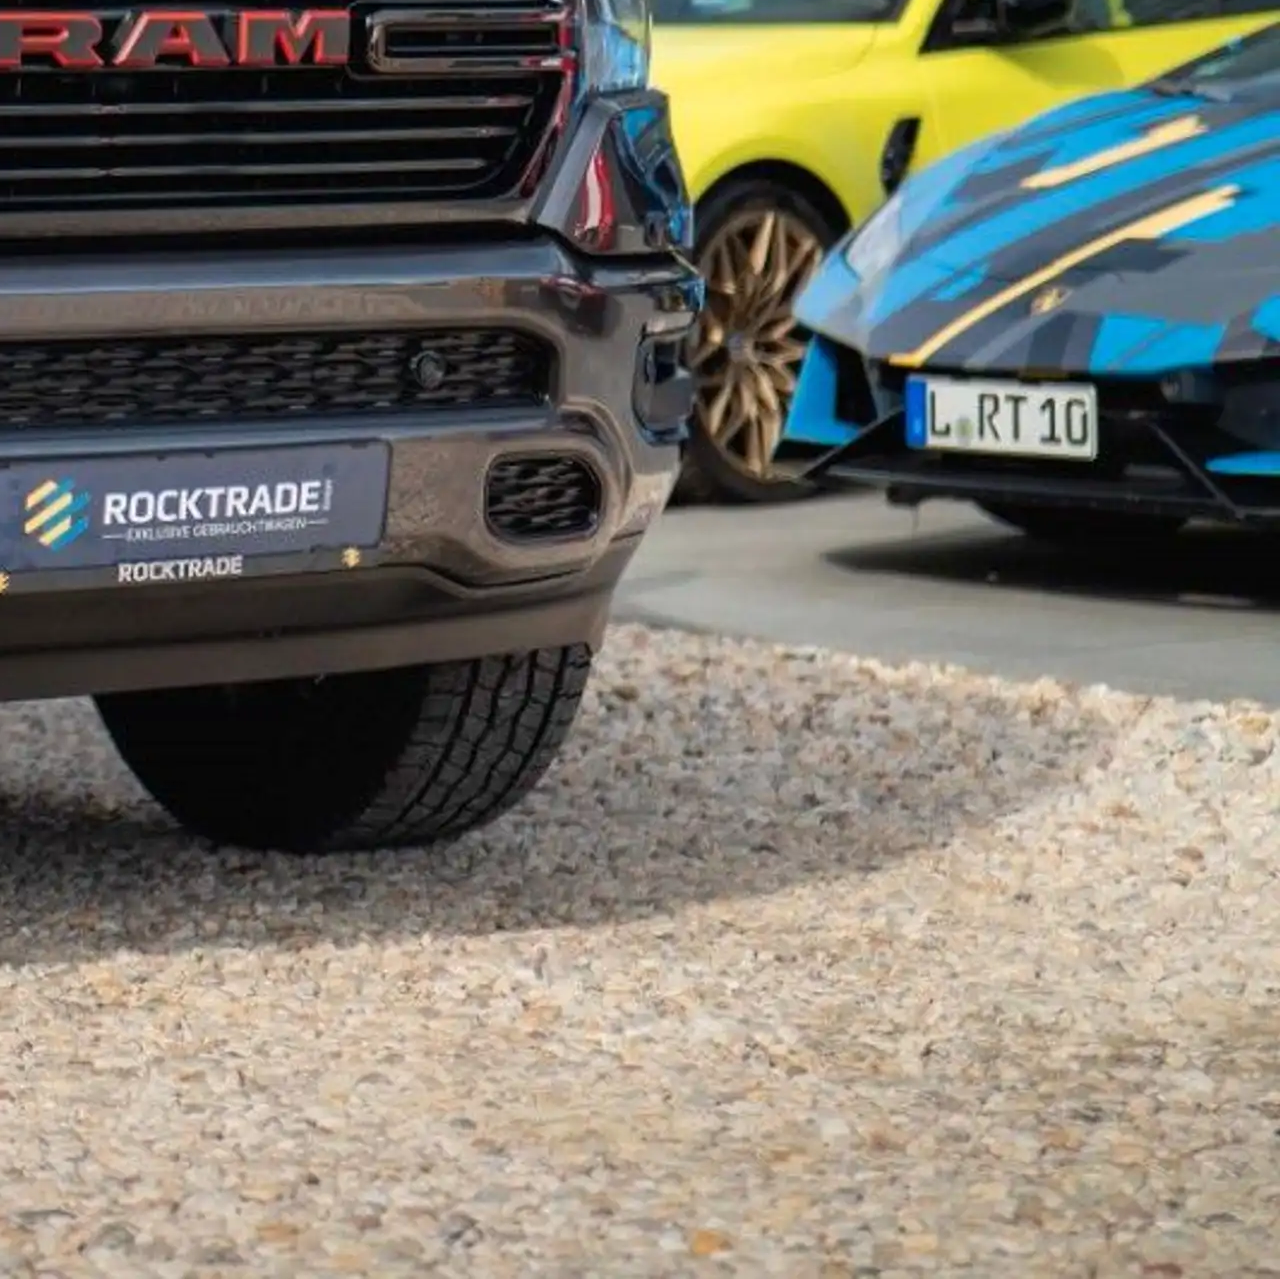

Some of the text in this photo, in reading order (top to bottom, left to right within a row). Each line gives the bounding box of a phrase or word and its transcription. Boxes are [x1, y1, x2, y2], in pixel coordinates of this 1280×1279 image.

[977, 393, 1028, 442] RT
[1040, 397, 1089, 446] 10
[102, 479, 322, 525] ROCKTRADE
[118, 555, 243, 582] ROCKTRADE
